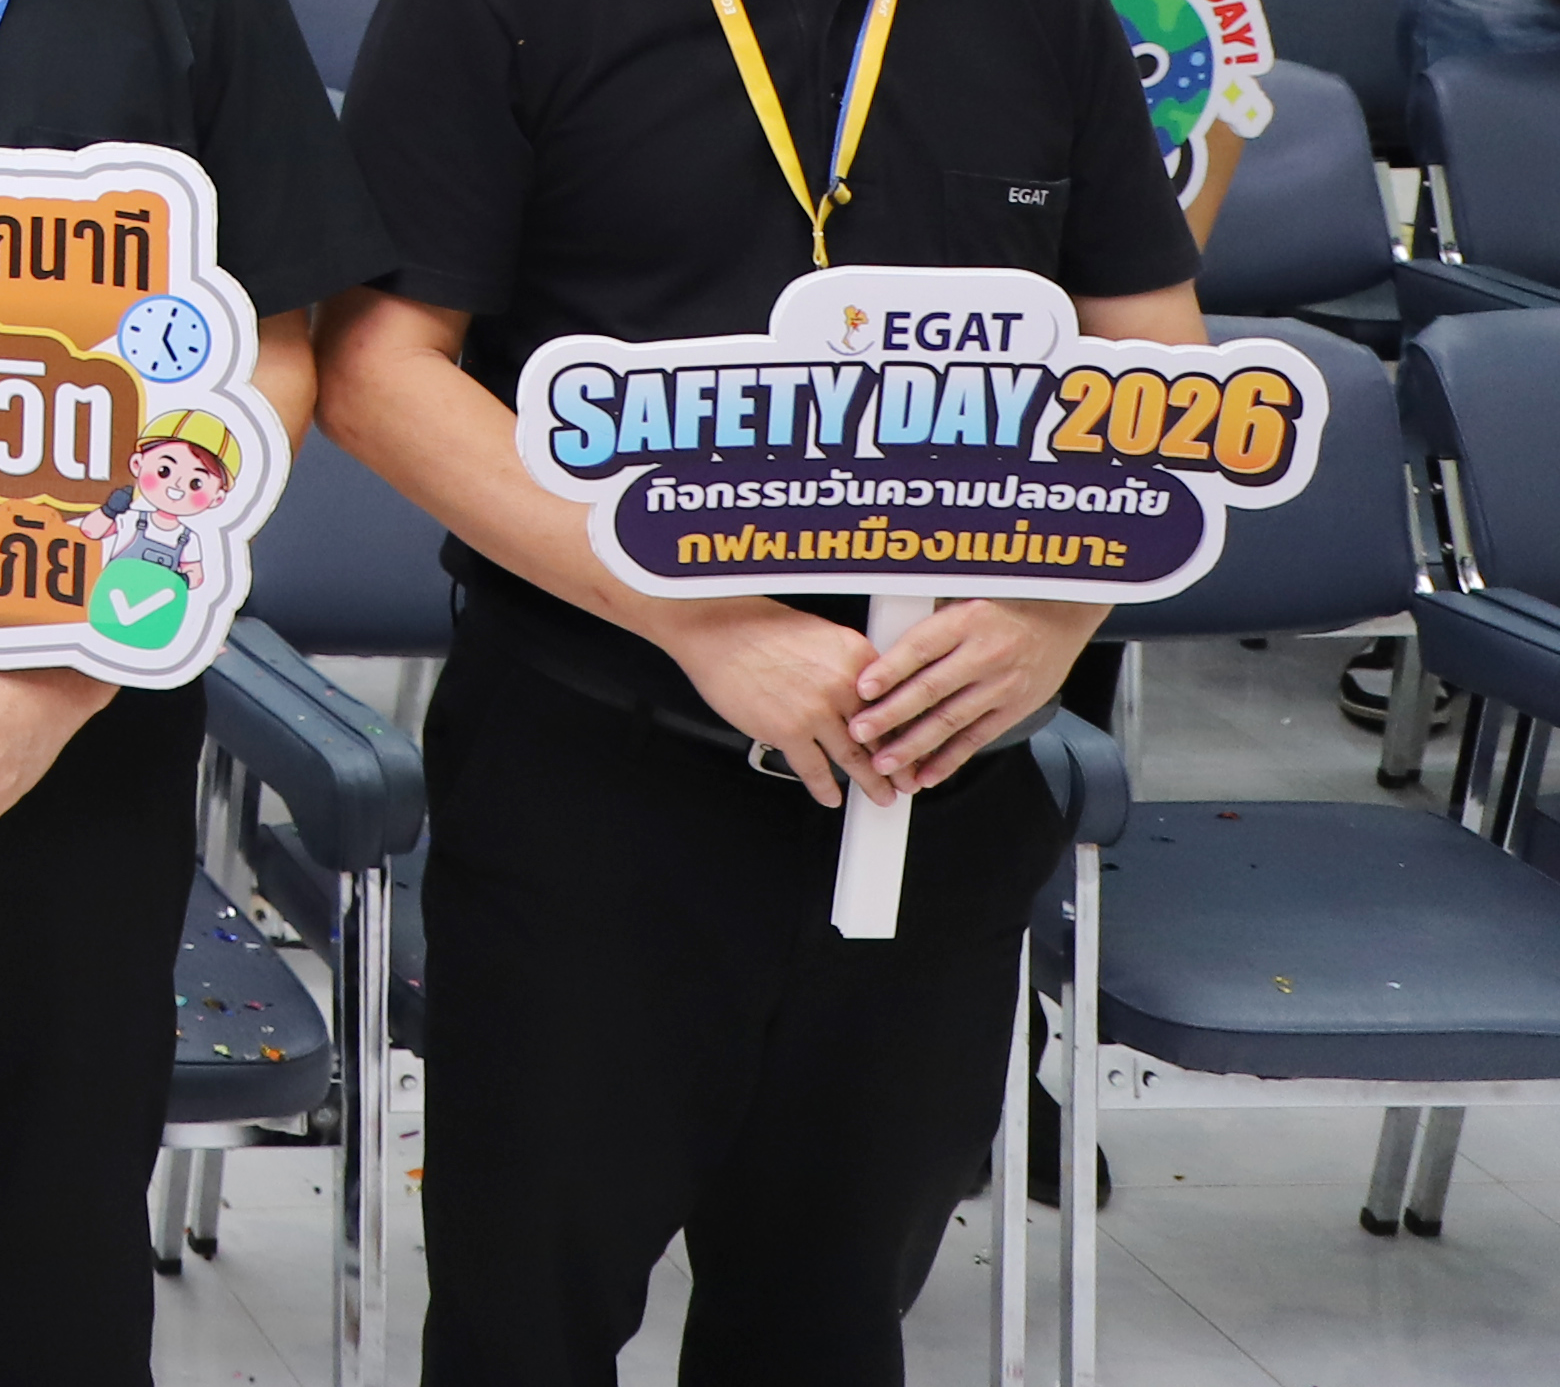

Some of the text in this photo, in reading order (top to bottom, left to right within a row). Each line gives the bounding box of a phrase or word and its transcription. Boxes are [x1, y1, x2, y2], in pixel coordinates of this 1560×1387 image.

[1008, 187, 1050, 206] EGAT
[881, 310, 1024, 354] EGAT
[551, 363, 1293, 476] SAFETY DAY 2026
[645, 469, 1171, 521] กิจกรรมวันความปลอดภัย
[676, 515, 1128, 572] กฟผ.เหมืองแม่เมาะ
